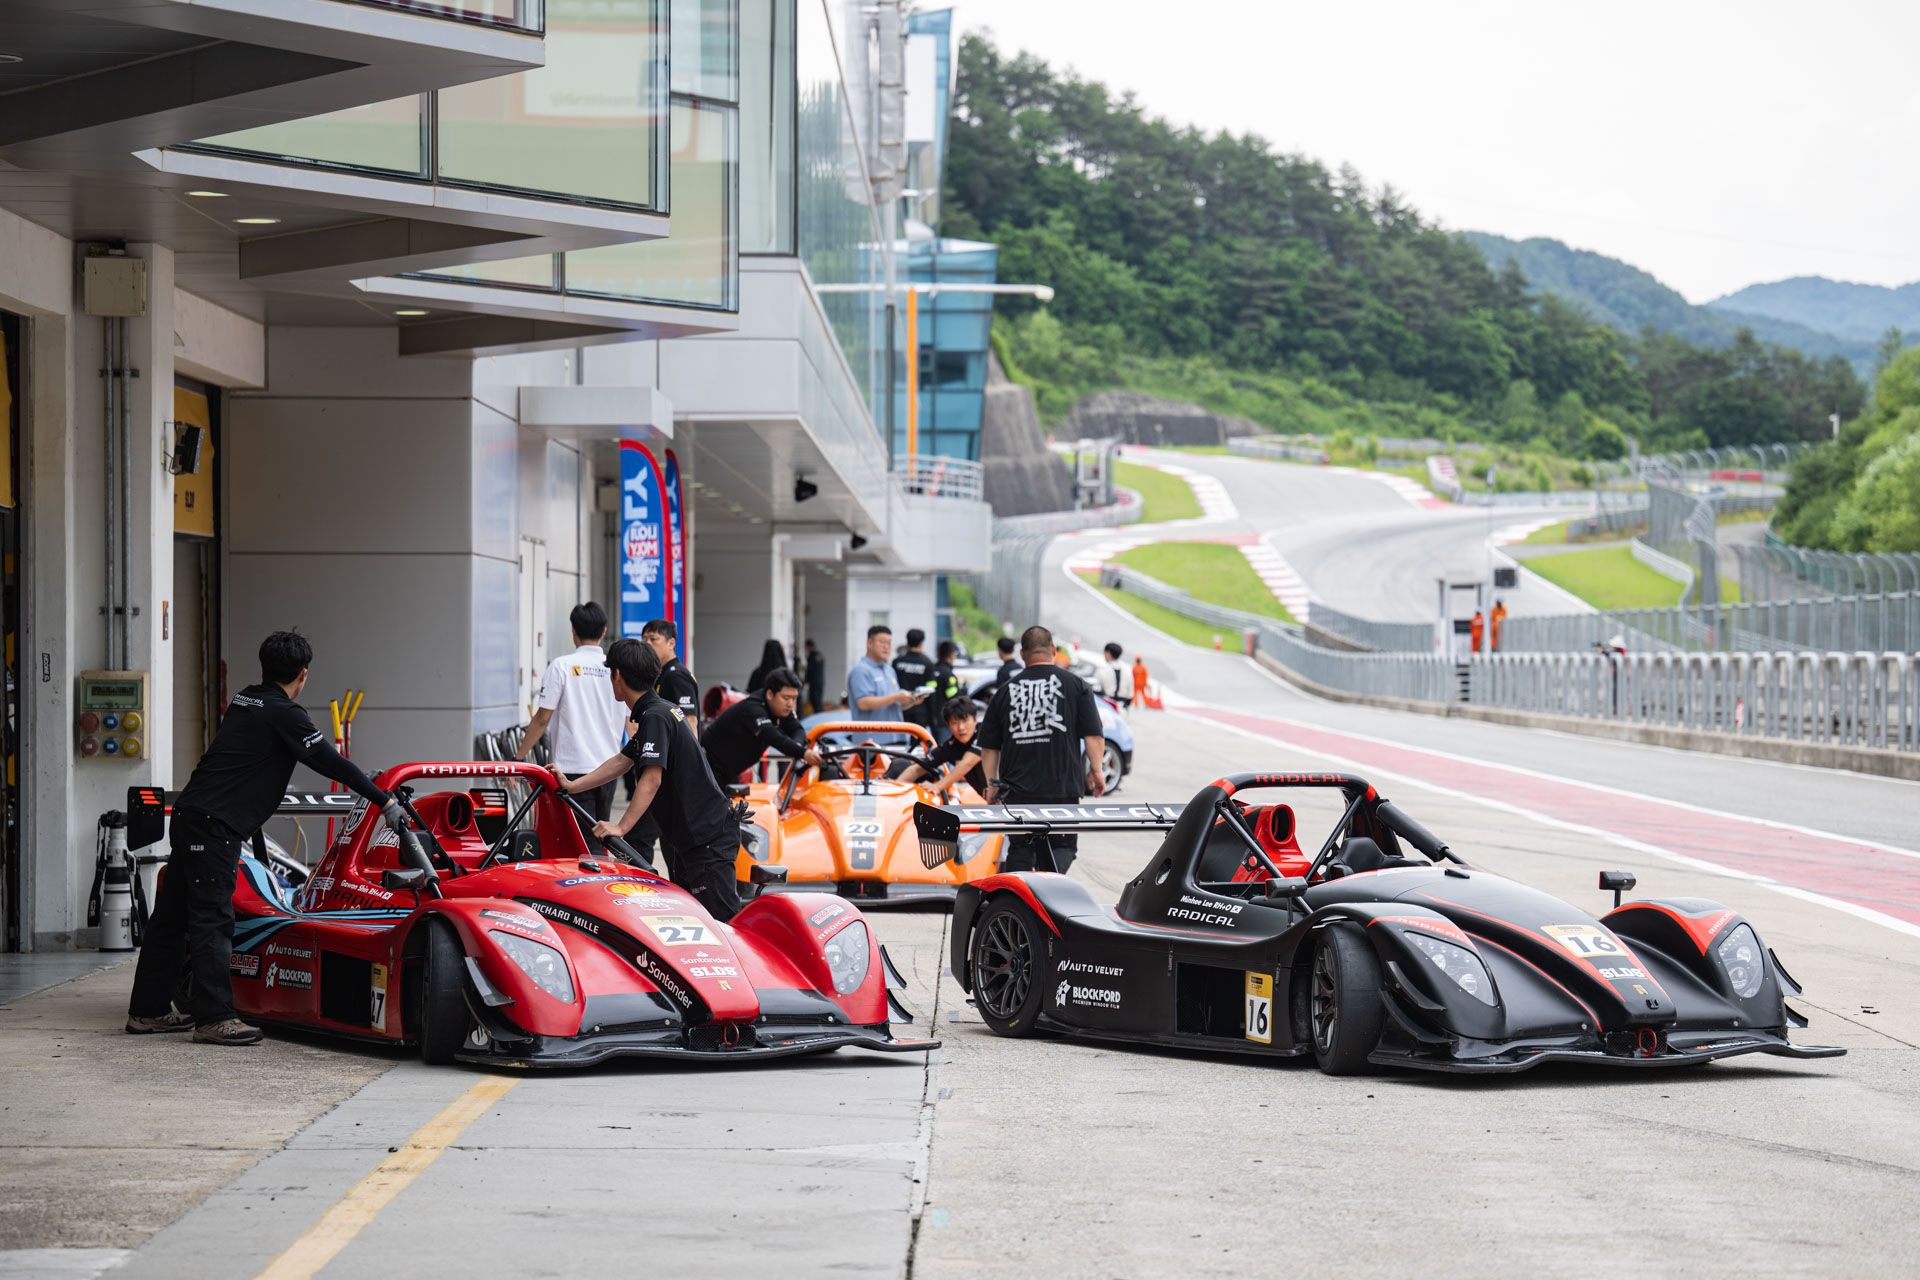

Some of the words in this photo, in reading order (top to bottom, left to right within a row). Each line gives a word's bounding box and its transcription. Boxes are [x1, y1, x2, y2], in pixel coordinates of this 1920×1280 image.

[1009, 674, 1066, 706] BETTER
[422, 765, 522, 774] RADICAL
[1255, 773, 1349, 783] RADICAL
[848, 823, 879, 834] 20
[1202, 900, 1213, 908] Lee
[531, 902, 571, 921] RICHARD
[573, 915, 600, 935] MILLE
[1167, 907, 1235, 927] RADICAL
[658, 926, 704, 942] 27
[1567, 936, 1617, 953] 16
[275, 946, 291, 955] AUTO
[293, 947, 311, 958] VELVET
[680, 957, 730, 965] Santander
[279, 969, 312, 983] BLOCKFORD
[689, 966, 738, 977] SLDS
[1069, 963, 1093, 972] AUTO
[1095, 965, 1123, 976] VELVET
[1599, 967, 1645, 978] SLDS
[648, 961, 692, 1009] Santander
[1073, 986, 1121, 1003] BLOCKFORD
[1249, 999, 1268, 1035] 16
